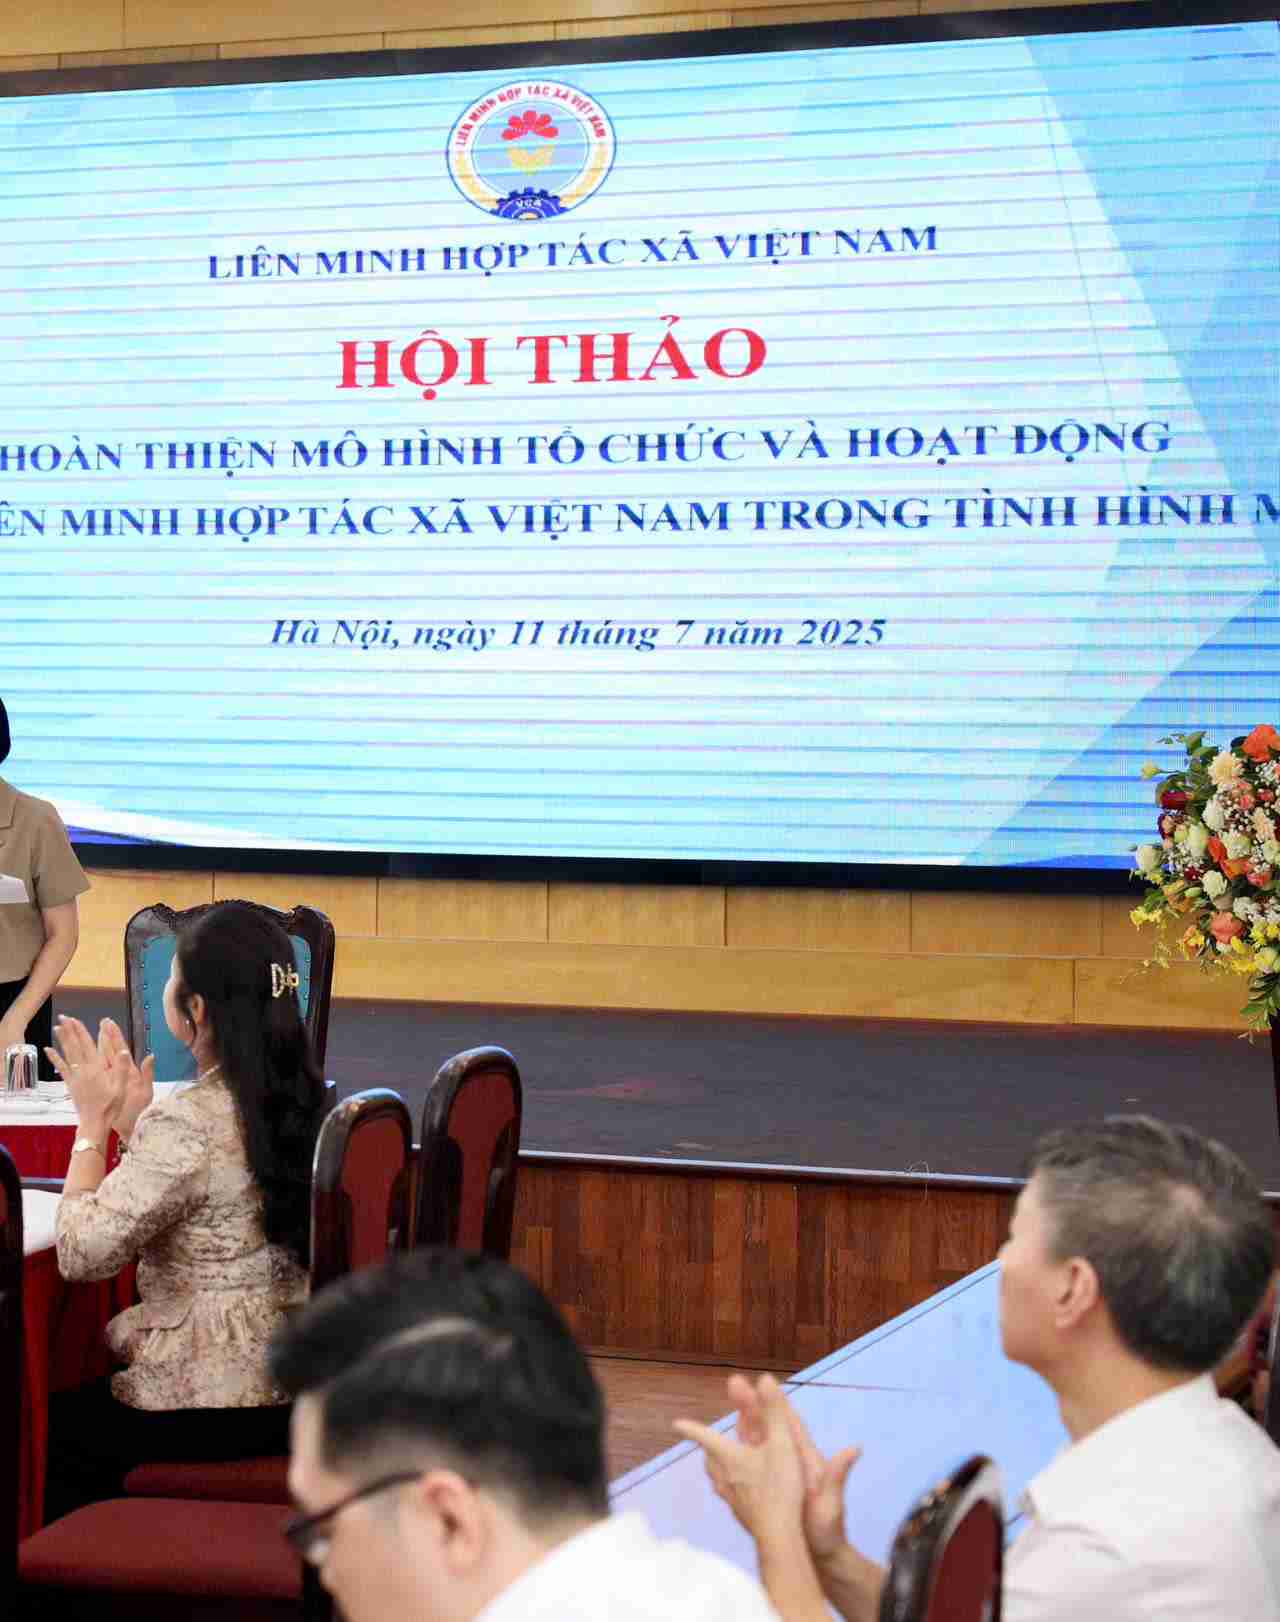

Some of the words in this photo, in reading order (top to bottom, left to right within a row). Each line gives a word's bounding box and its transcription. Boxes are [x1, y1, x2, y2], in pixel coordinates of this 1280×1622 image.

[208, 244, 302, 279] LIÊN
[316, 248, 424, 276] MINH
[447, 240, 529, 277] HỢP
[539, 233, 627, 269] TÁC
[640, 228, 700, 264] XÃ
[716, 226, 822, 266] VIỆT
[833, 225, 939, 255] NAM
[335, 329, 492, 401] HỘI
[516, 314, 768, 387] THẢO
[136, 435, 276, 477] THIỆN
[291, 429, 368, 469] MÔ
[382, 431, 503, 467] HÌNH
[516, 424, 585, 465] TỔ
[599, 422, 747, 464] CHỨC
[760, 421, 826, 460] VÀ
[848, 424, 1000, 465] HOẠT
[1009, 418, 1171, 463] ĐỘNG
[59, 507, 180, 538] MINH
[194, 503, 290, 543] HỢP
[297, 498, 395, 536] TÁC
[408, 497, 474, 535] XÃ
[487, 497, 602, 541] VIỆT
[616, 501, 730, 533] NAM
[744, 497, 930, 532] TRONG
[945, 488, 1080, 528] TÌNH
[1096, 486, 1236, 527] HÌNH
[270, 618, 320, 646] Hà
[331, 617, 400, 650] Nội,
[413, 620, 497, 652] ngày
[511, 619, 545, 646] 11
[557, 618, 659, 652] tháng
[675, 619, 696, 647] 7
[705, 620, 783, 646] năm
[797, 618, 887, 646] 2025
